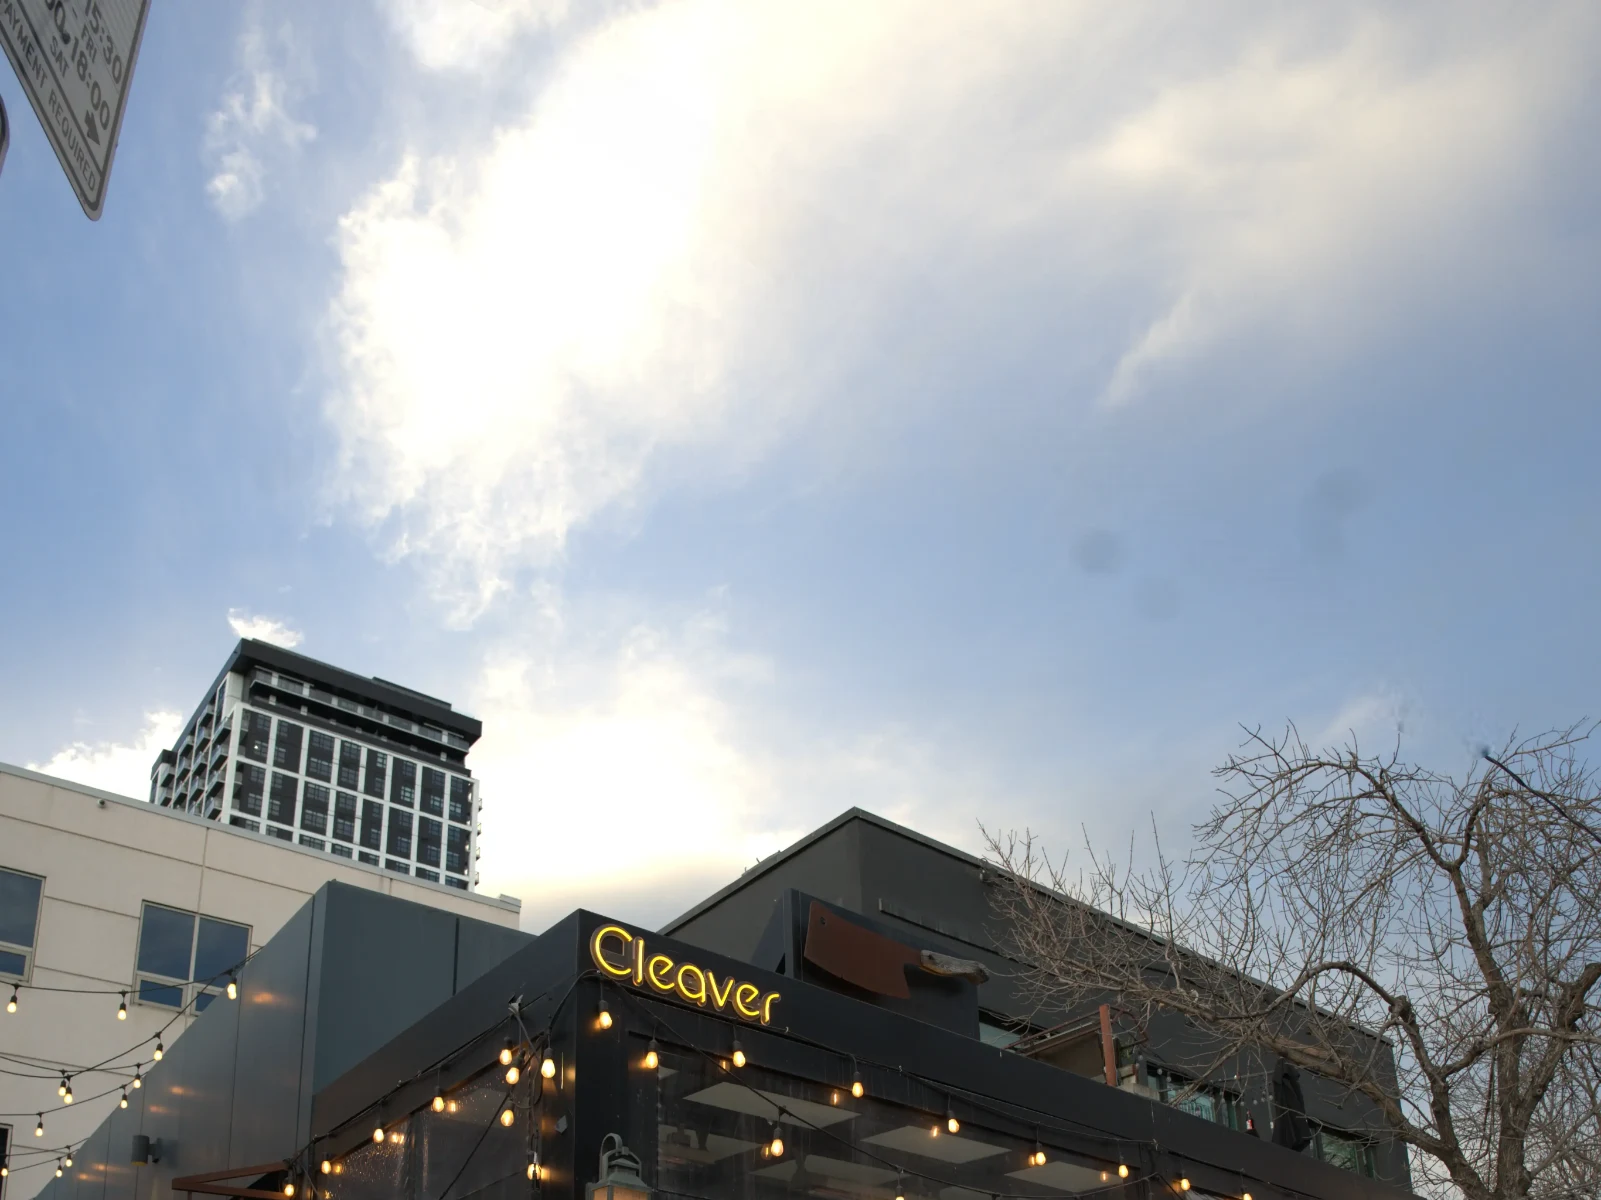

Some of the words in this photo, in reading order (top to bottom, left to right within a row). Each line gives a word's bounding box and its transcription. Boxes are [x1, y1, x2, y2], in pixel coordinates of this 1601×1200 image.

[50, 36, 70, 78] SAT
[71, 36, 110, 130] 18:00
[81, 24, 97, 64] FRI
[4, 0, 48, 88] AYMENT
[48, 89, 96, 192] REQUIRED
[590, 924, 781, 1025] Cleaver
